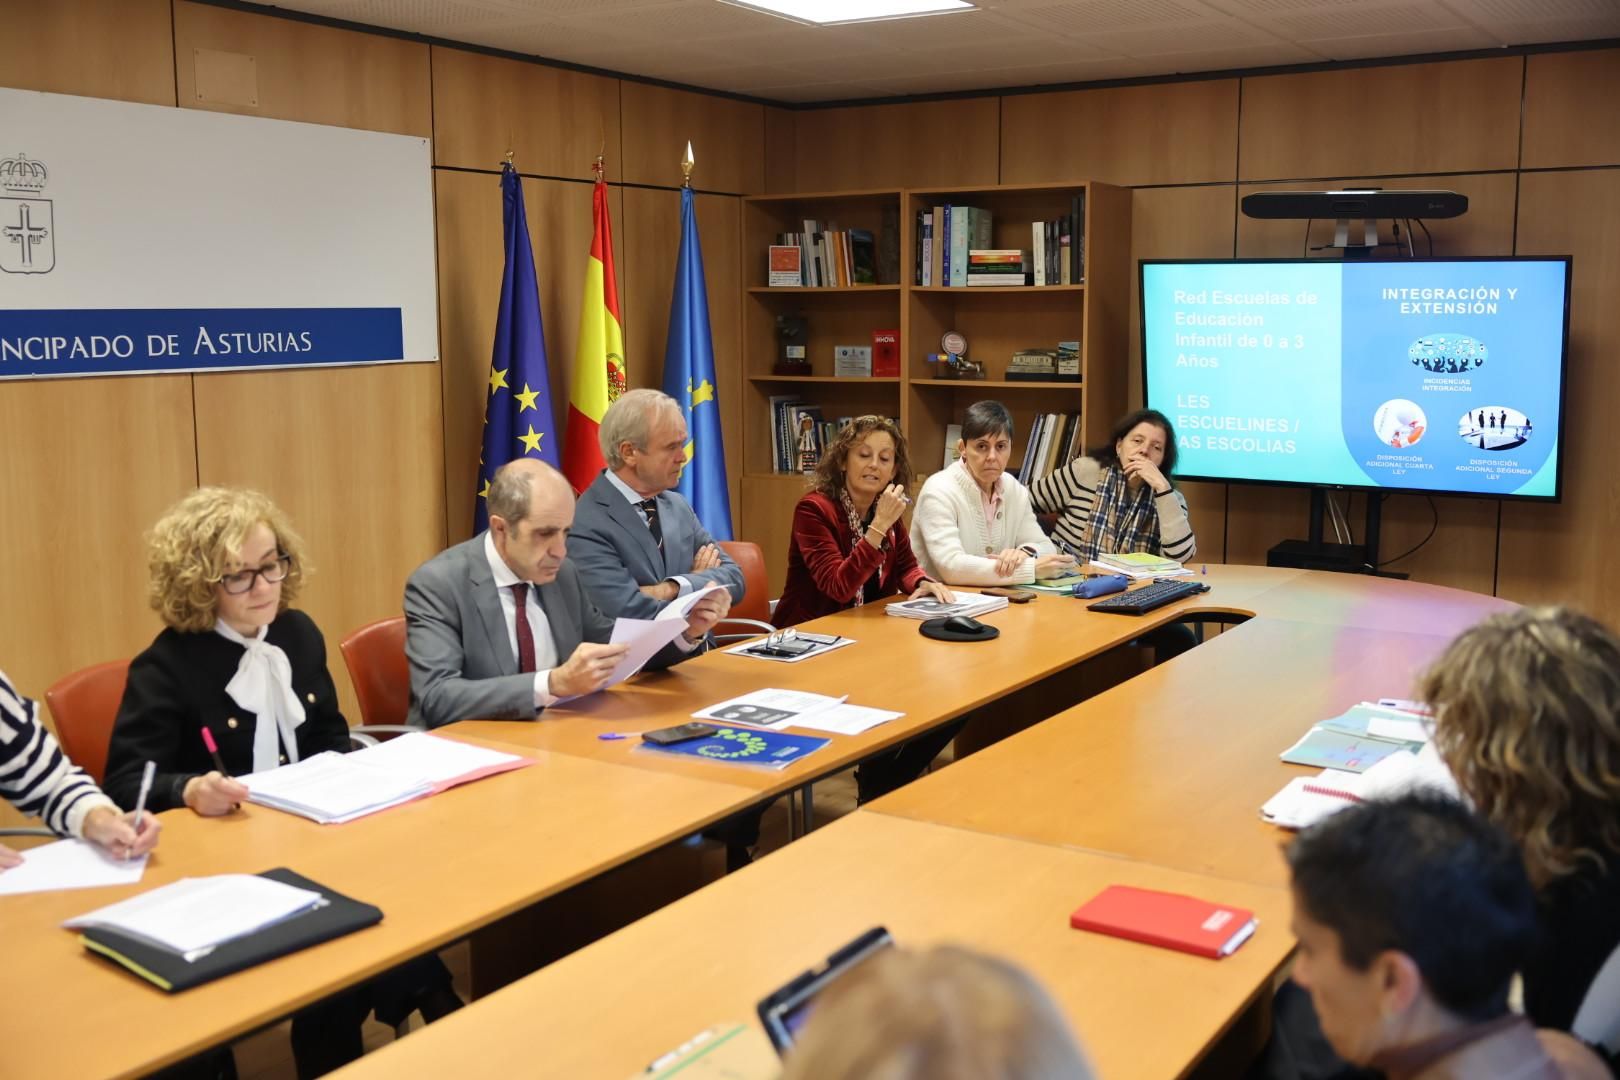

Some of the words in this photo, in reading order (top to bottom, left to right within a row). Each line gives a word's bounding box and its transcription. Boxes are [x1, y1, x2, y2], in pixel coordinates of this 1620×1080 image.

[1174, 289, 1207, 304] Red
[1212, 290, 1290, 305] Escuelas
[1295, 290, 1318, 305] de
[1382, 286, 1500, 300] INTEGRACIÓN
[1507, 287, 1518, 300] Y
[1400, 301, 1497, 314] EXTENSIÓN
[1174, 311, 1264, 327] Educación
[147, 335, 180, 357] DE
[194, 326, 312, 355] ASTURIAS
[1175, 332, 1232, 347] Infantil
[1237, 333, 1258, 348] de
[1263, 334, 1273, 348] 0
[1279, 337, 1289, 348] a
[1294, 334, 1305, 349] 3
[1176, 353, 1219, 368] Años
[1177, 394, 1210, 408] LES
[1178, 415, 1289, 433] ESCUELINES
[1294, 418, 1301, 433] /
[1178, 435, 1201, 449] AS
[1207, 436, 1296, 454] ESCOLIAS
[1376, 454, 1423, 462] DISPOSICIÓN
[1470, 458, 1518, 467] DISPOSICIÓN
[1405, 462, 1434, 470] CUARTA
[1456, 465, 1494, 473] ADICIONAL
[1496, 467, 1532, 475] SEGUNDA
